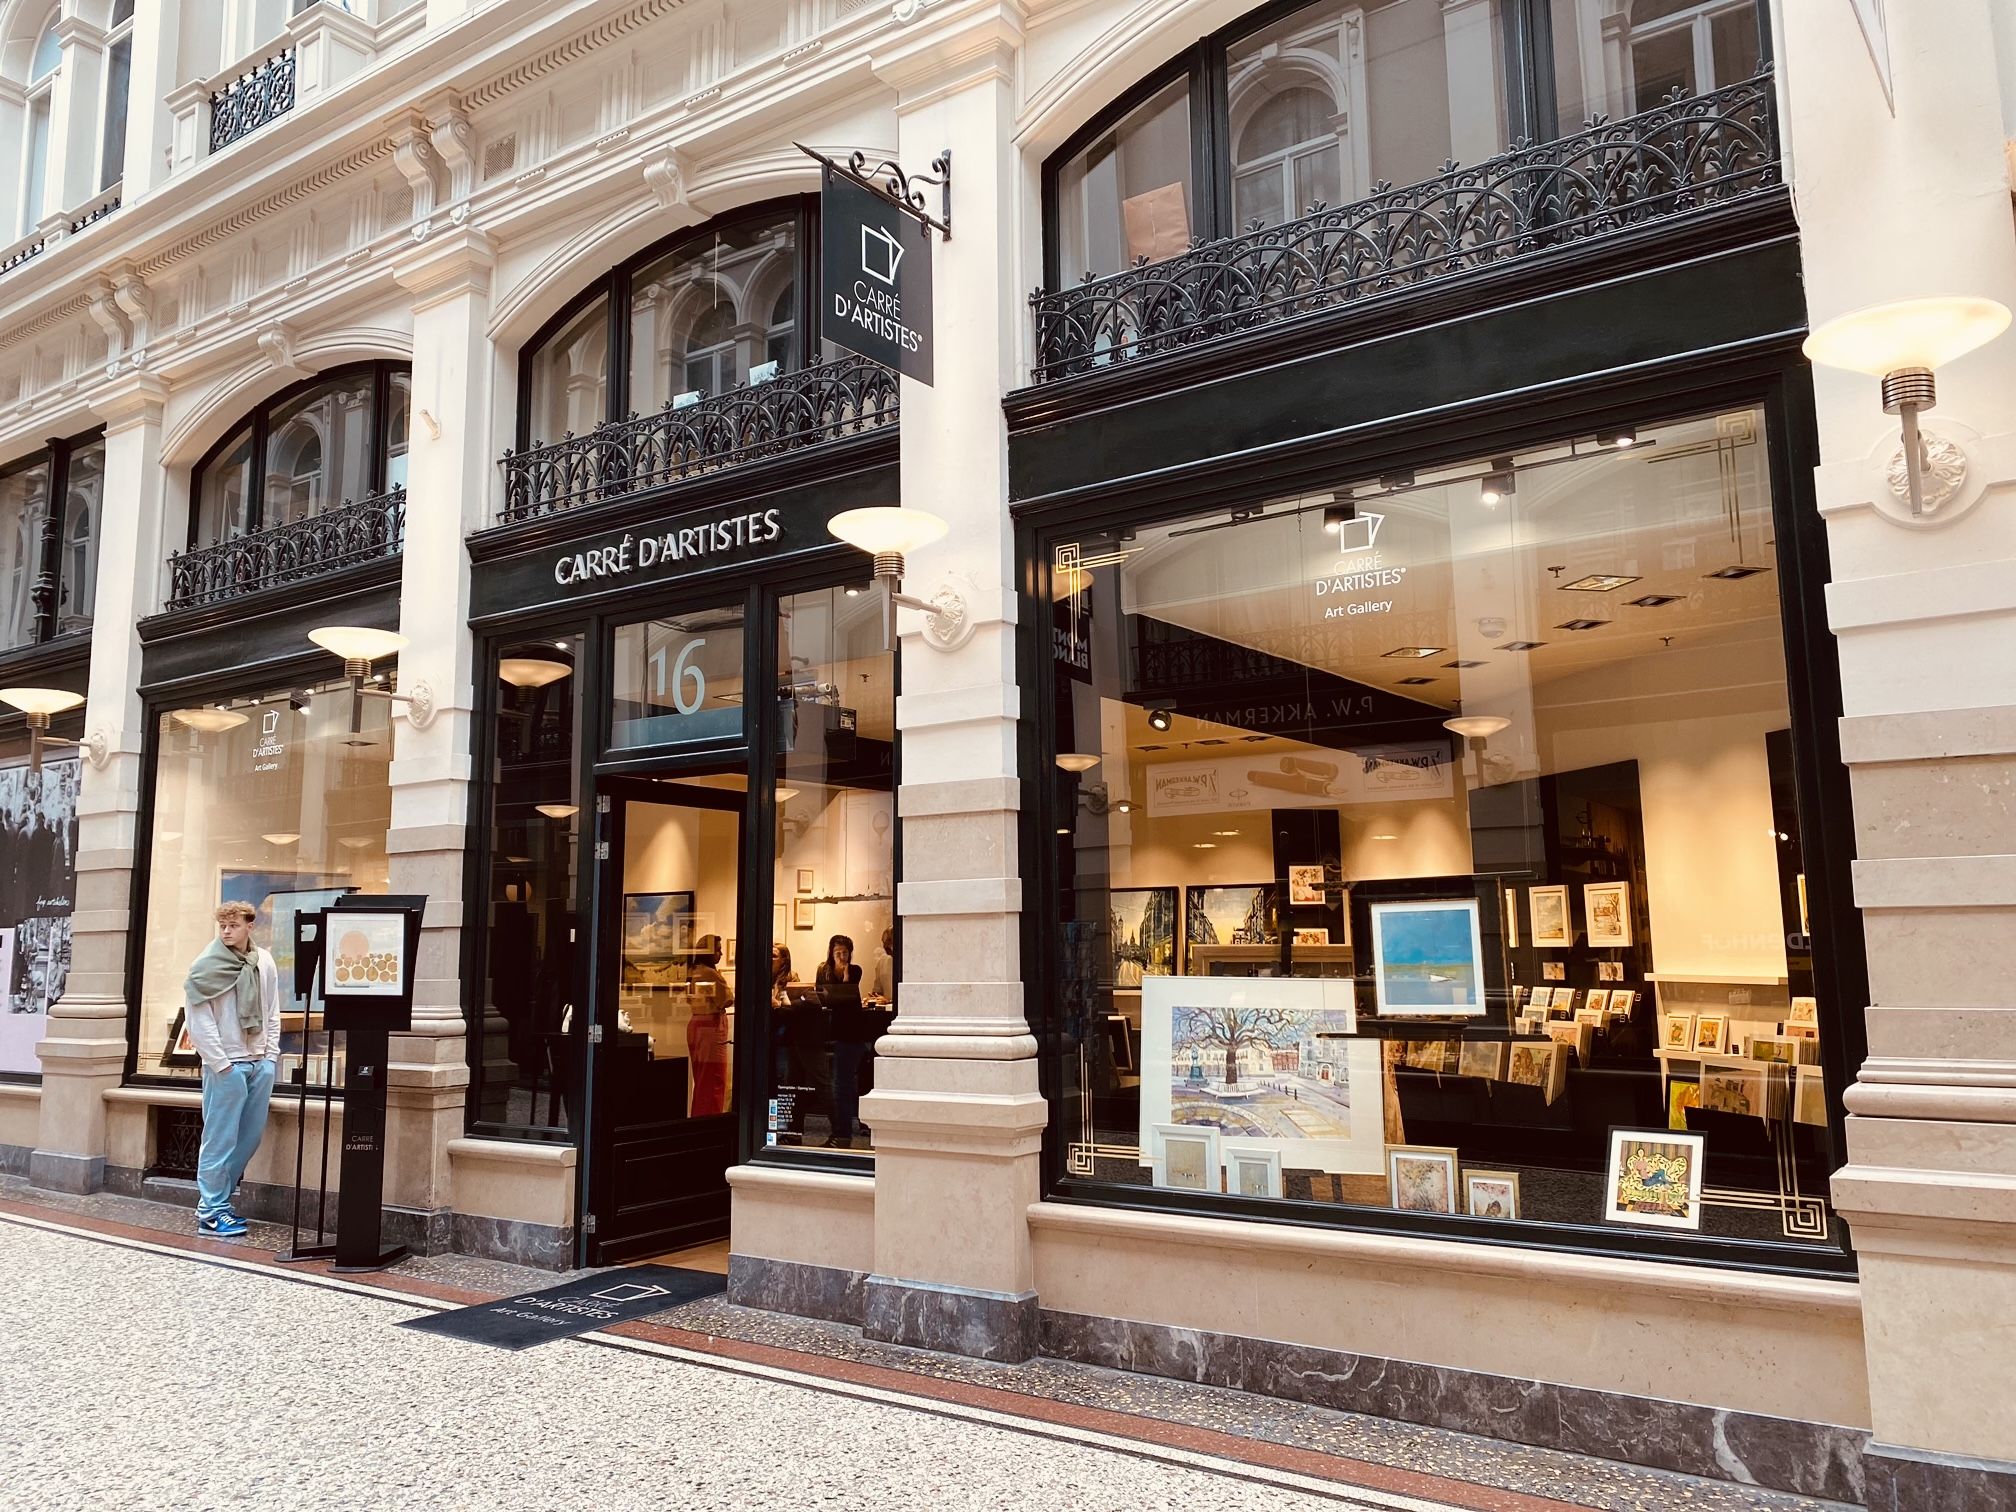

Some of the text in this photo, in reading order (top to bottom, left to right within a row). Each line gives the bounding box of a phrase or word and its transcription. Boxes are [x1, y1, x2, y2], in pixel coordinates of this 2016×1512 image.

[854, 280, 901, 321] CARRÉ
[554, 508, 783, 585] CARRÉ D'ARTISTES
[1334, 551, 1383, 576] CARRÉ
[1324, 600, 1393, 619] Art Gallery
[649, 638, 706, 715] 16
[490, 1307, 517, 1316] Art
